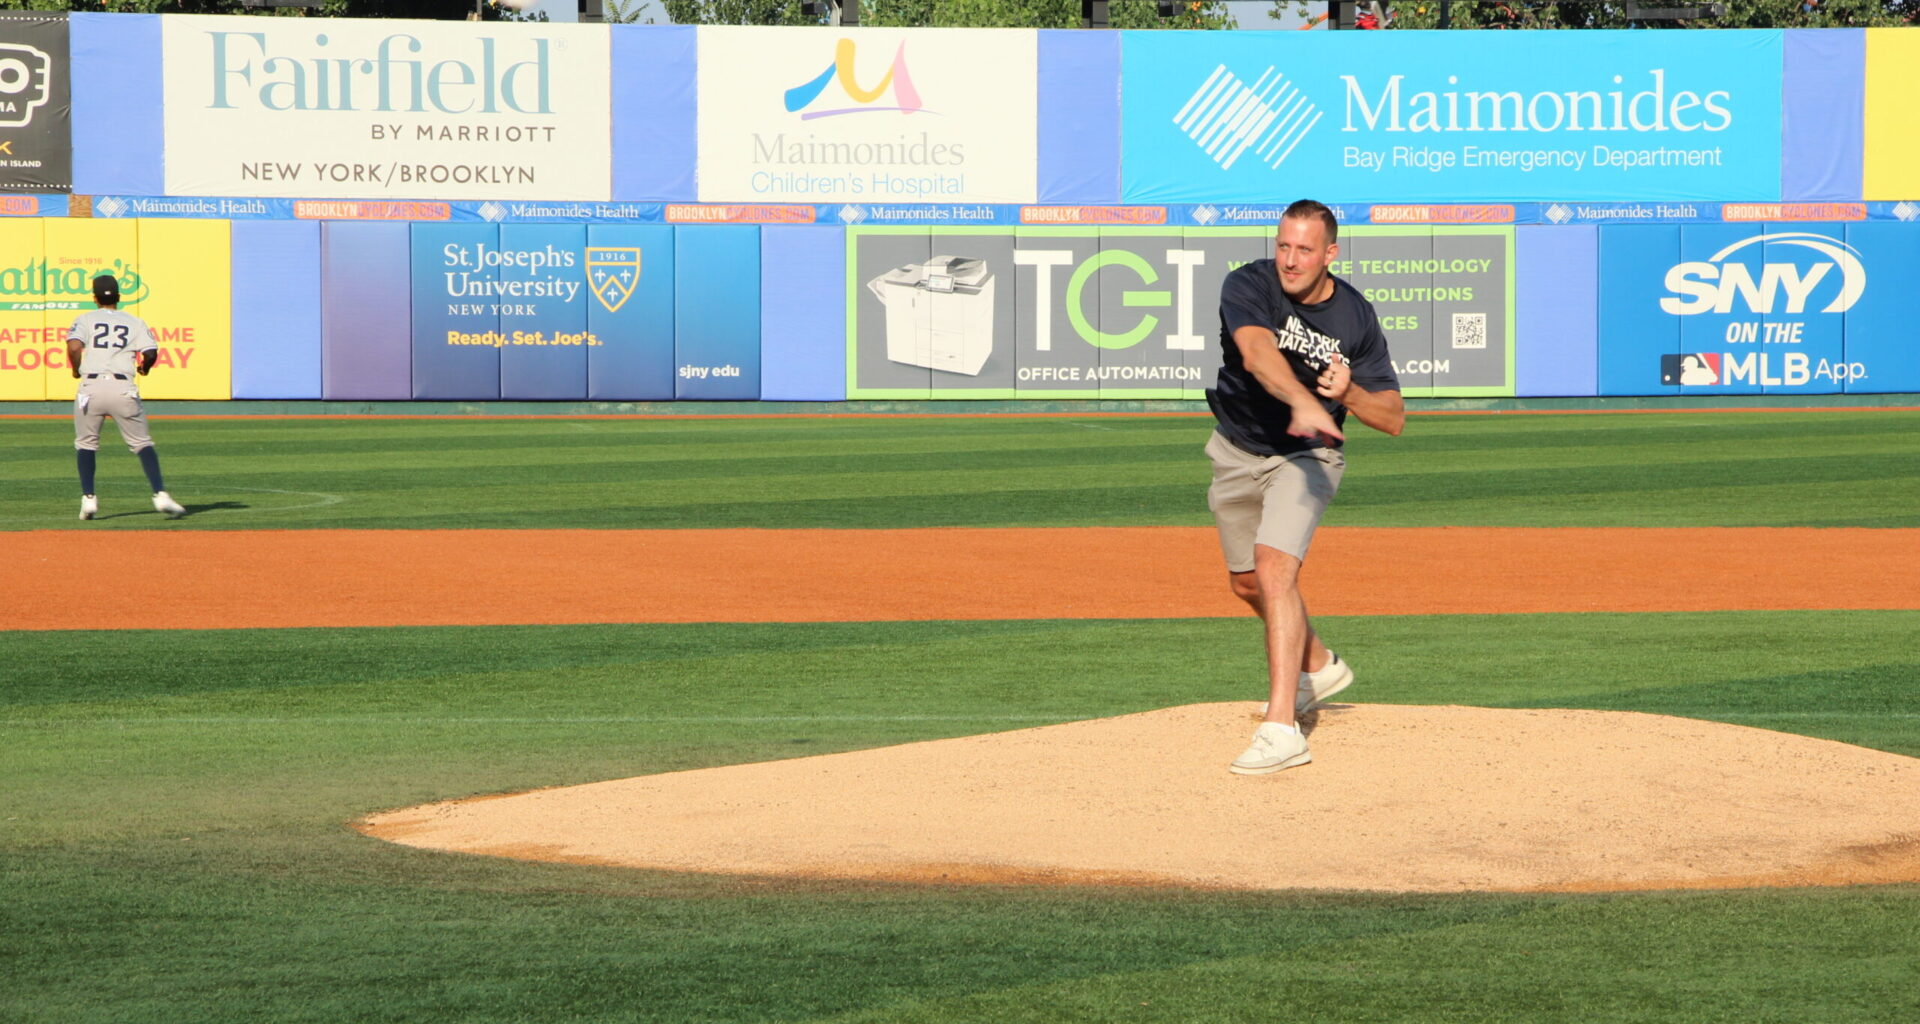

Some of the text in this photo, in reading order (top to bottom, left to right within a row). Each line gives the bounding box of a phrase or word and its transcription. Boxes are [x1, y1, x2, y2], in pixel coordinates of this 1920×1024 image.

[203, 31, 556, 114] Fairfield
[1339, 68, 1732, 133] Maimonides
[371, 124, 556, 142] BY MARRIOTT
[751, 132, 965, 166] Maimonides
[10, 160, 42, 168] ISLAND
[1343, 145, 1722, 172] Bay Ridge Emergency Department
[241, 161, 536, 188] NEW YORK/BROOKLYN
[751, 171, 965, 198] Children's Hospital
[132, 199, 266, 214] Maimonides Health
[511, 203, 639, 219] Maimonides Health
[871, 206, 994, 220] Maimonides Health
[1223, 207, 1286, 220] Maimoni
[1577, 205, 1697, 220] Maimonides Health
[59, 257, 103, 265] Since 1916
[473, 243, 576, 276] Joseph's
[599, 252, 627, 261] 1916
[1359, 259, 1491, 274] TECHNOLOGY
[444, 271, 581, 302] University
[1363, 287, 1473, 302] SOLUTIONS
[1659, 262, 1835, 316] SNY
[11, 302, 80, 310] FAMOUS
[1014, 249, 1205, 351] TGI
[448, 304, 537, 316] NEW YORK
[0, 327, 194, 344] AFTER AME
[93, 323, 129, 349] 23
[447, 331, 604, 348] Ready. Set. Joe's.
[1725, 322, 1804, 344] ON THE
[1017, 366, 1202, 381] OFFICE AUTOMATION
[1723, 352, 1811, 386] MLB
